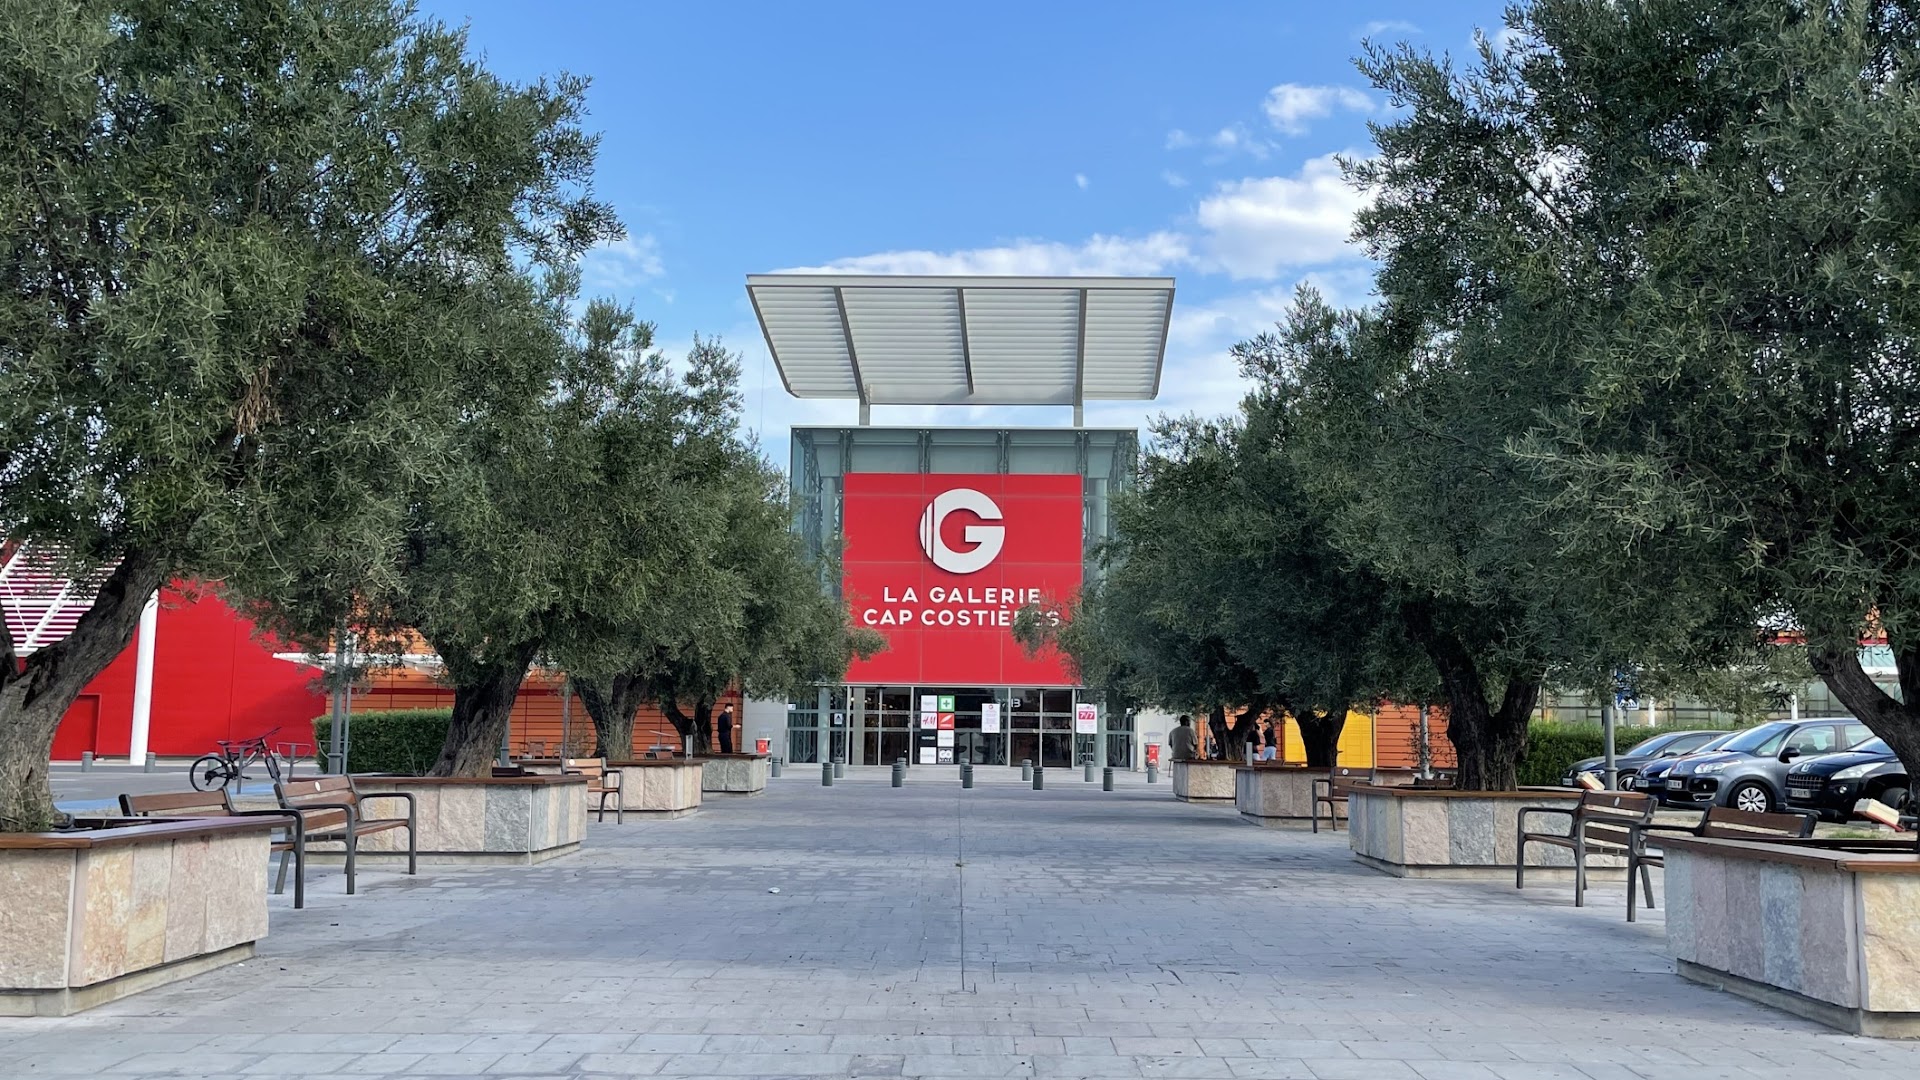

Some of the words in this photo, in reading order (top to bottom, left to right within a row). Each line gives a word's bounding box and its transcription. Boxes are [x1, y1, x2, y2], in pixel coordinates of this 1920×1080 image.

[919, 488, 1006, 574] G
[883, 586, 918, 603] LA
[929, 586, 1041, 604] GALERIE
[863, 609, 913, 626] CAP
[920, 605, 1060, 627] COSTIÈS
